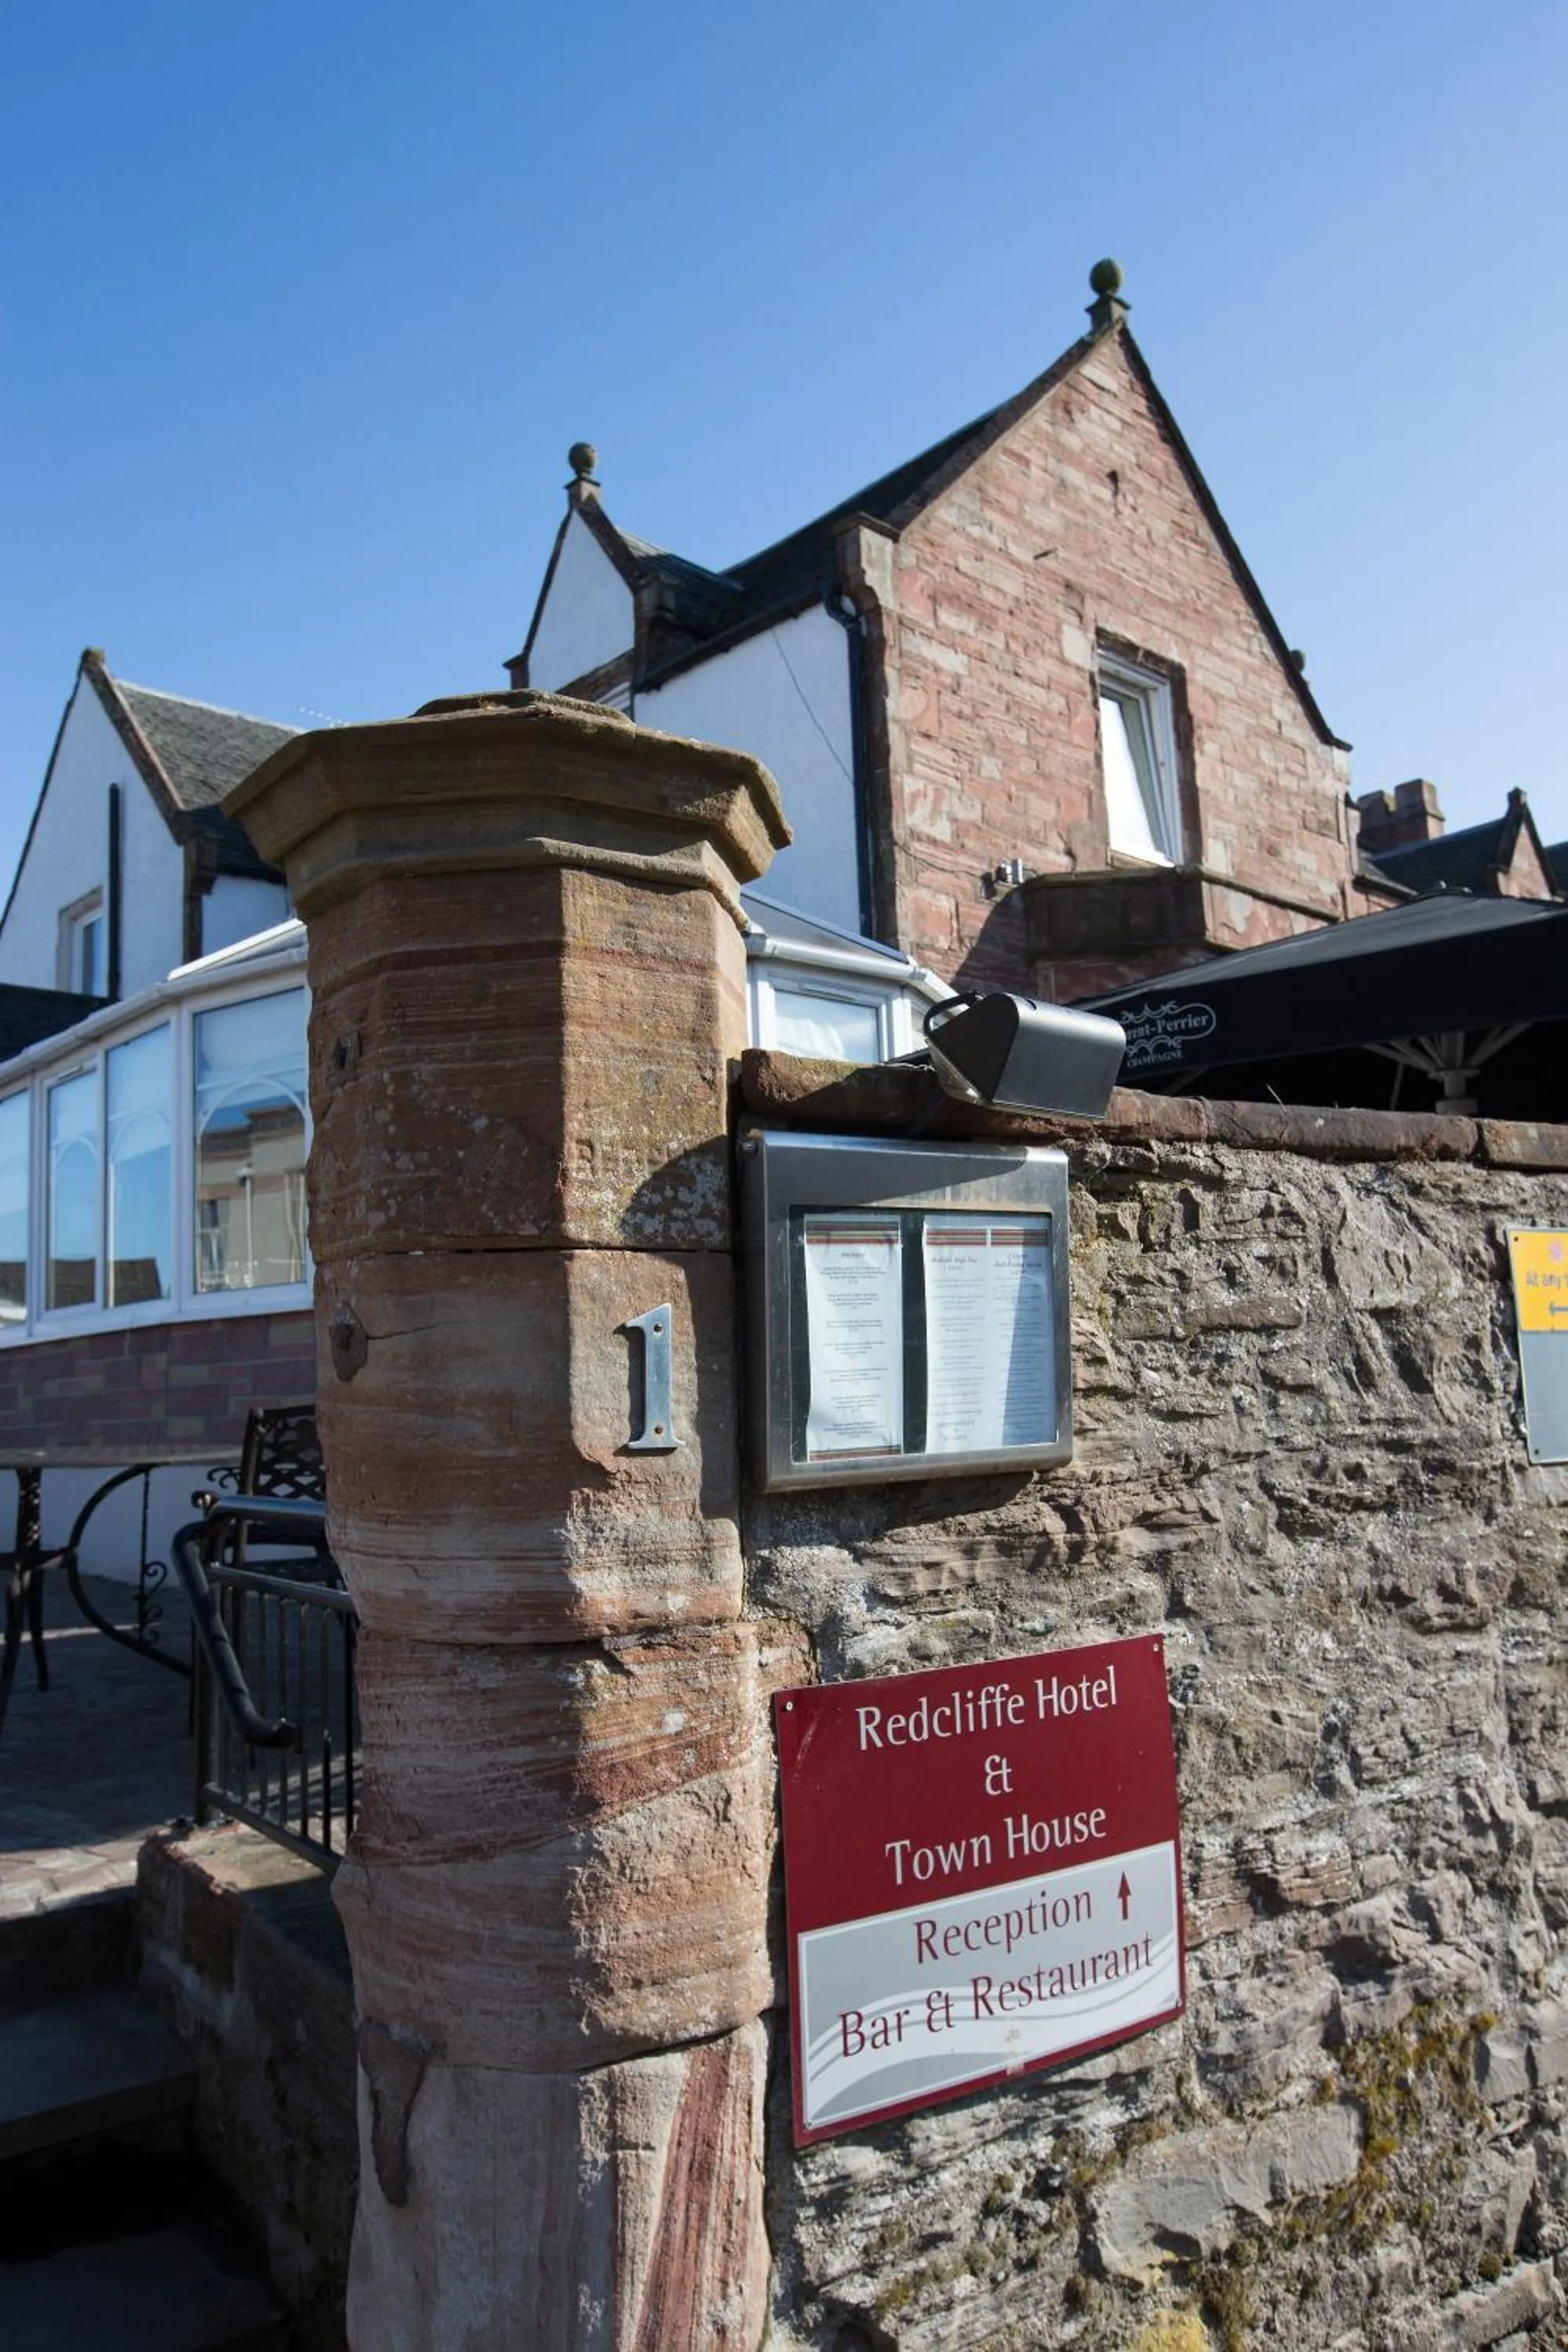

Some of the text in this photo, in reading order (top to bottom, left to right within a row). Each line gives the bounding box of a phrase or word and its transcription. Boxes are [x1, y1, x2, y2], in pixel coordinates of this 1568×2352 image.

[1127, 1013, 1210, 1040] rent-Perrier
[624, 1302, 686, 1450] 1
[855, 1664, 1118, 1751] Redcliffe Hotel
[984, 1754, 1014, 1796] &
[884, 1807, 1107, 1886] Town House
[913, 1890, 1092, 1965] Reception
[839, 1932, 1155, 2059] Bar & Restaurant
